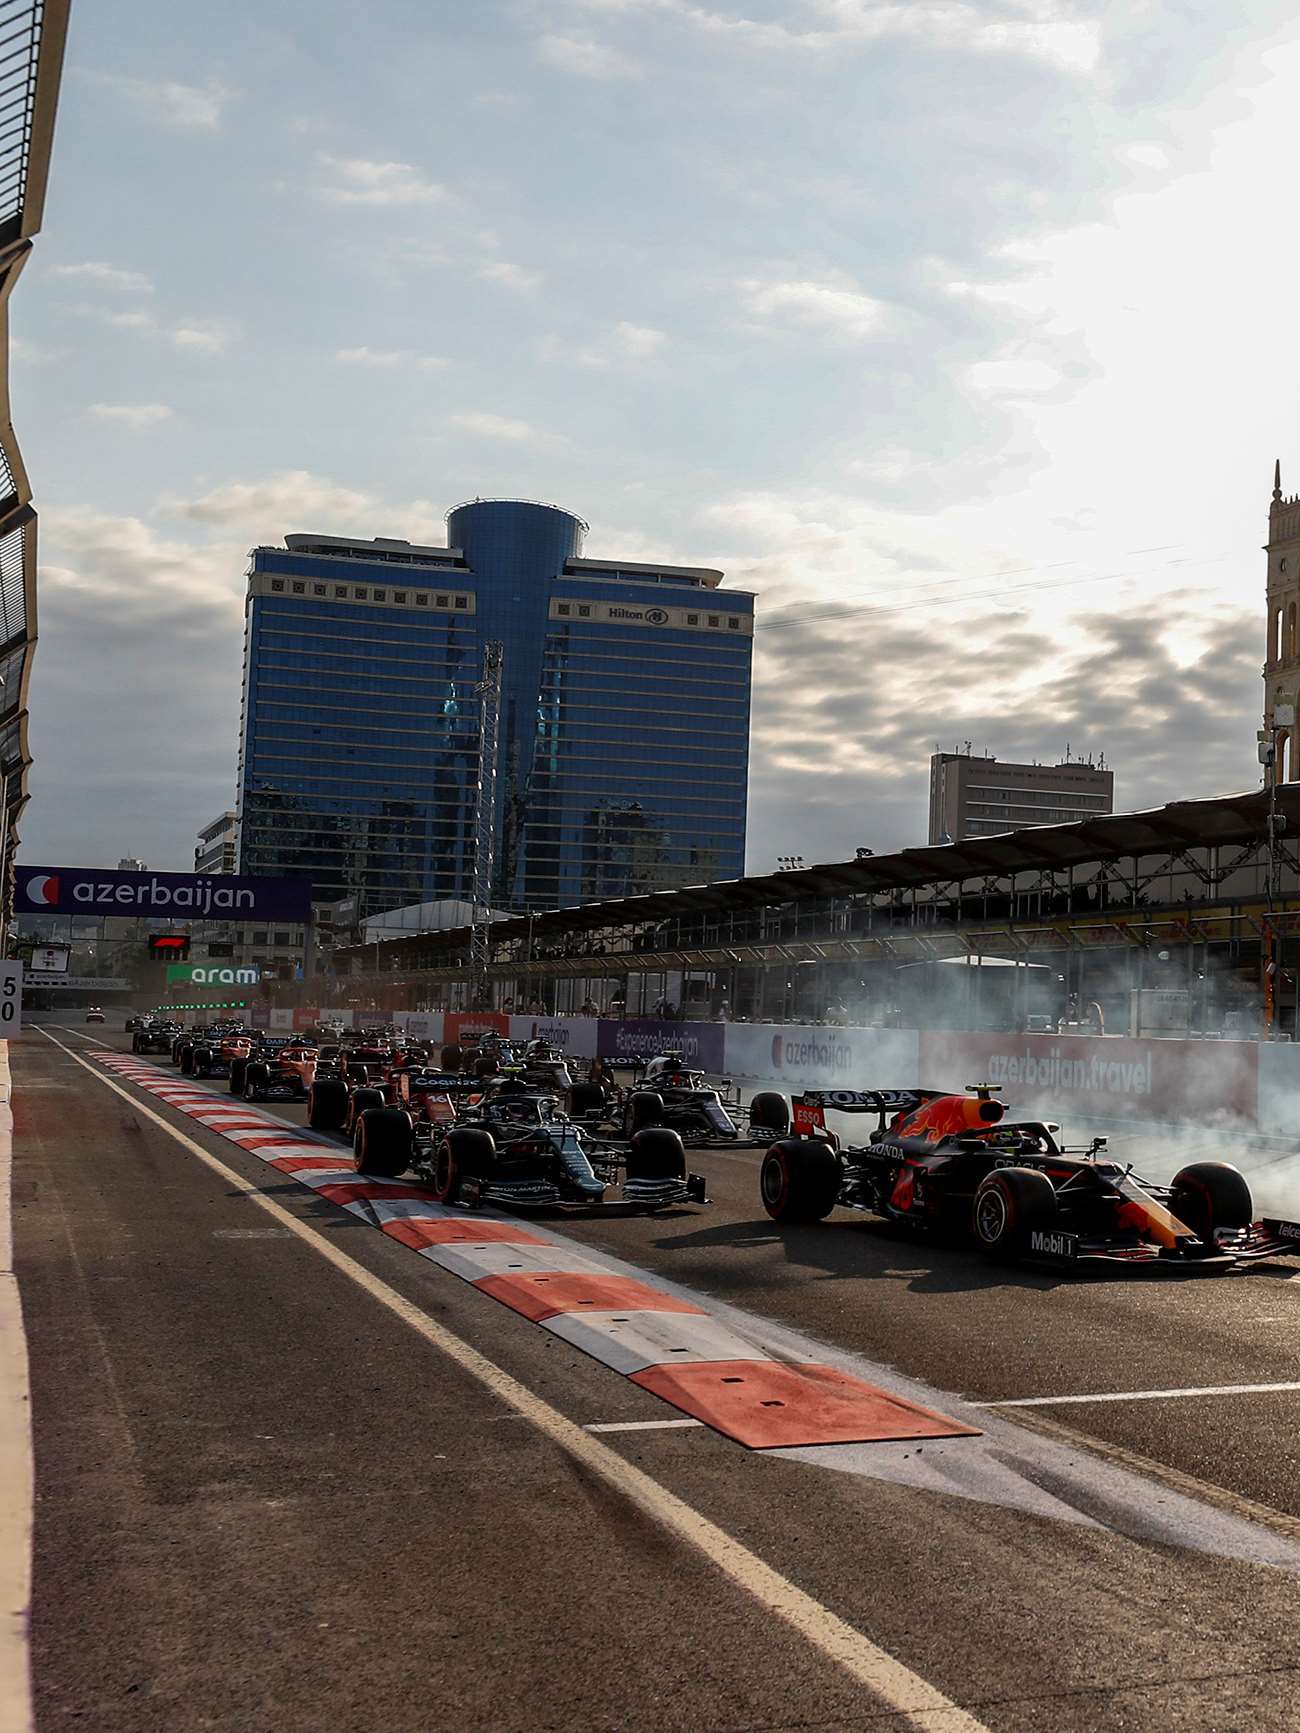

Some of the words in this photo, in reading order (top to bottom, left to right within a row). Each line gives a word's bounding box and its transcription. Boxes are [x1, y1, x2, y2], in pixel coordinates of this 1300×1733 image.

[609, 608, 643, 620] Hilton
[73, 878, 256, 914] azerbaijan
[191, 967, 260, 985] aram
[797, 1109, 821, 1124] ESSO
[868, 1143, 905, 1160] HONDA
[1031, 1231, 1064, 1255] Mobil
